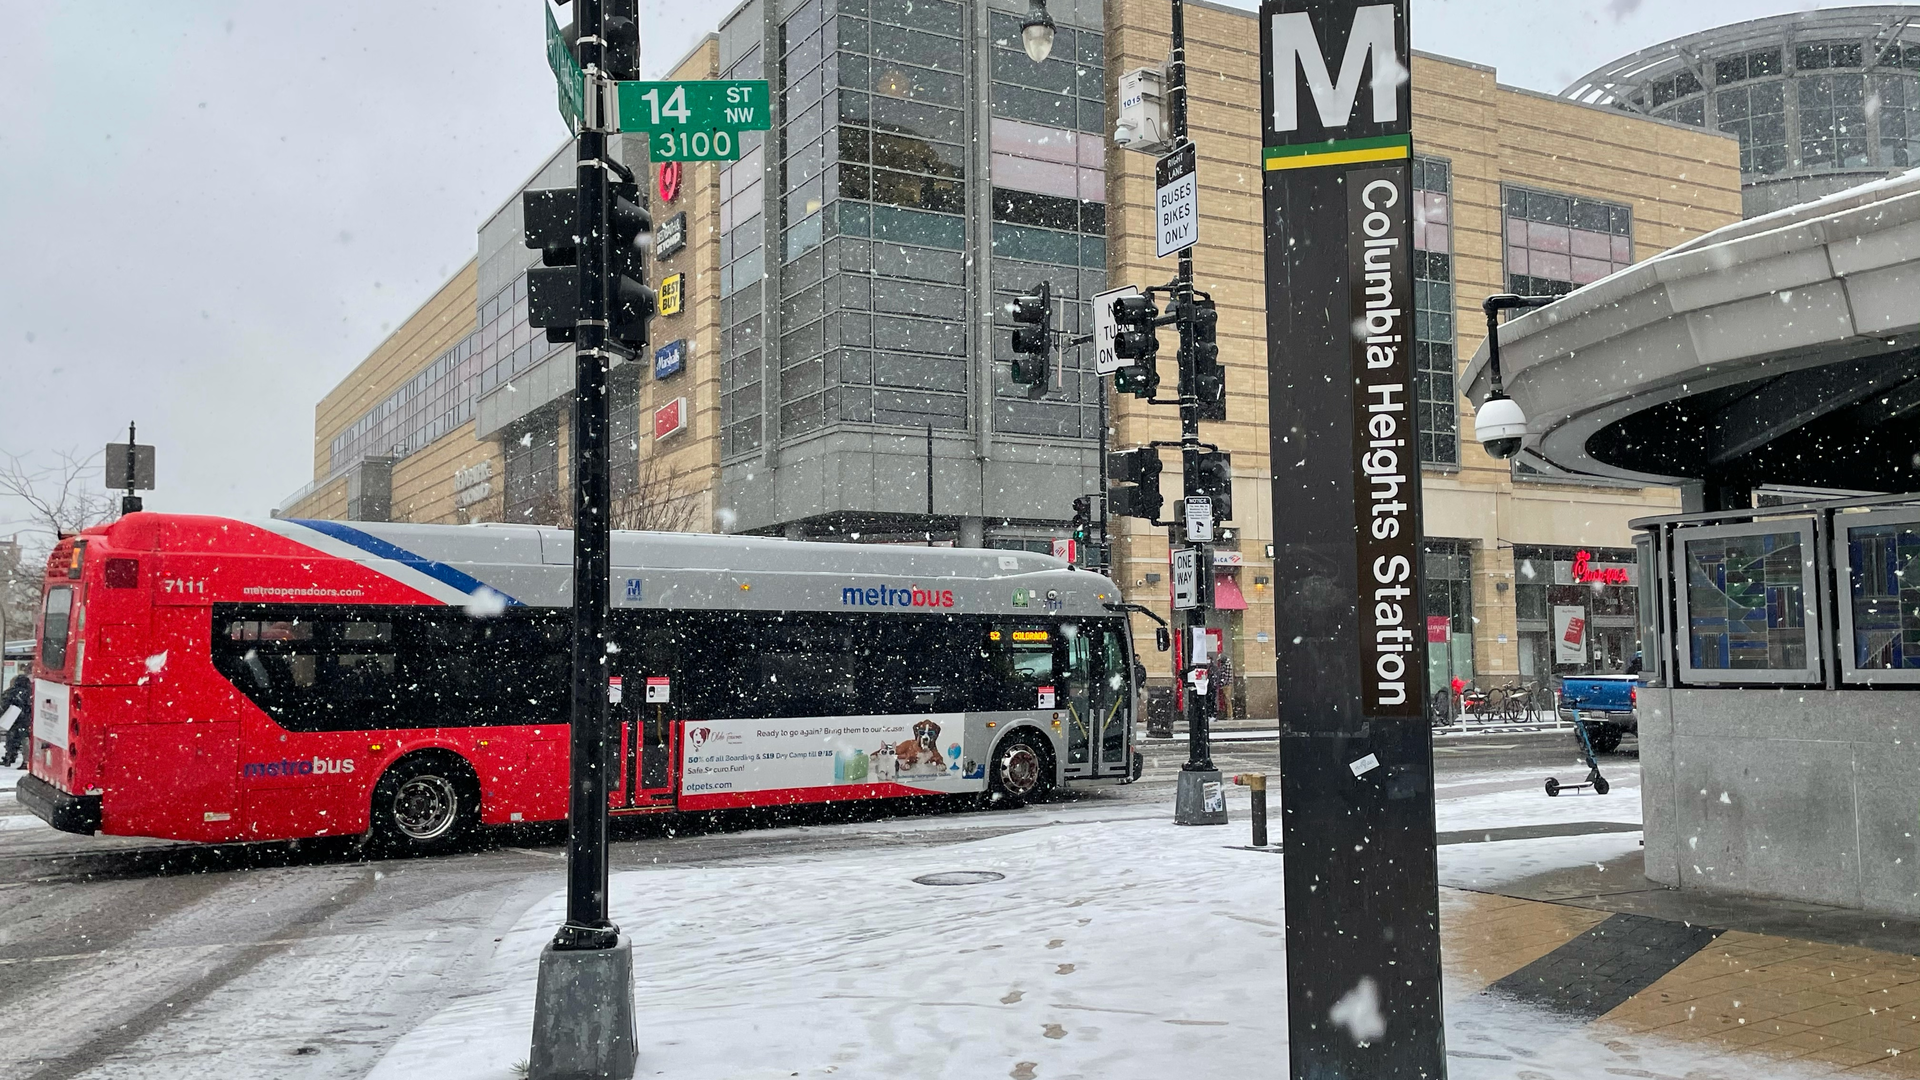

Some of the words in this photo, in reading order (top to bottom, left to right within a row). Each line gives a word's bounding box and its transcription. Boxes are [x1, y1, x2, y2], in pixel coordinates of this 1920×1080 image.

[1272, 4, 1397, 132] M
[641, 85, 691, 124] 14
[726, 87, 752, 103] ST
[1123, 95, 1141, 108] 1015
[726, 107, 754, 123] NW
[659, 131, 731, 157] 3100
[1167, 152, 1183, 168] RIGHT
[1168, 165, 1183, 181] LANE
[1161, 182, 1191, 208] BUSES
[1164, 203, 1190, 227] BIKES
[1165, 223, 1189, 245] ONLY
[1361, 179, 1402, 370] Columbia
[662, 281, 679, 298] BEST
[662, 297, 677, 311] BUY
[1100, 348, 1113, 364] ON
[1362, 383, 1407, 541] Heights
[1177, 555, 1192, 569] ONE
[1177, 571, 1192, 585] WAY
[164, 580, 204, 593] 7111
[842, 584, 955, 608] metrobus
[1012, 631, 1048, 641] COLORADO
[1372, 555, 1412, 706] Station
[756, 729, 779, 739] Ready
[789, 730, 798, 738] go
[800, 728, 822, 738] again?
[824, 727, 842, 736] Bring
[789, 751, 807, 759] Camp
[244, 755, 355, 777] metrobus
[686, 781, 732, 791] otpets.com
